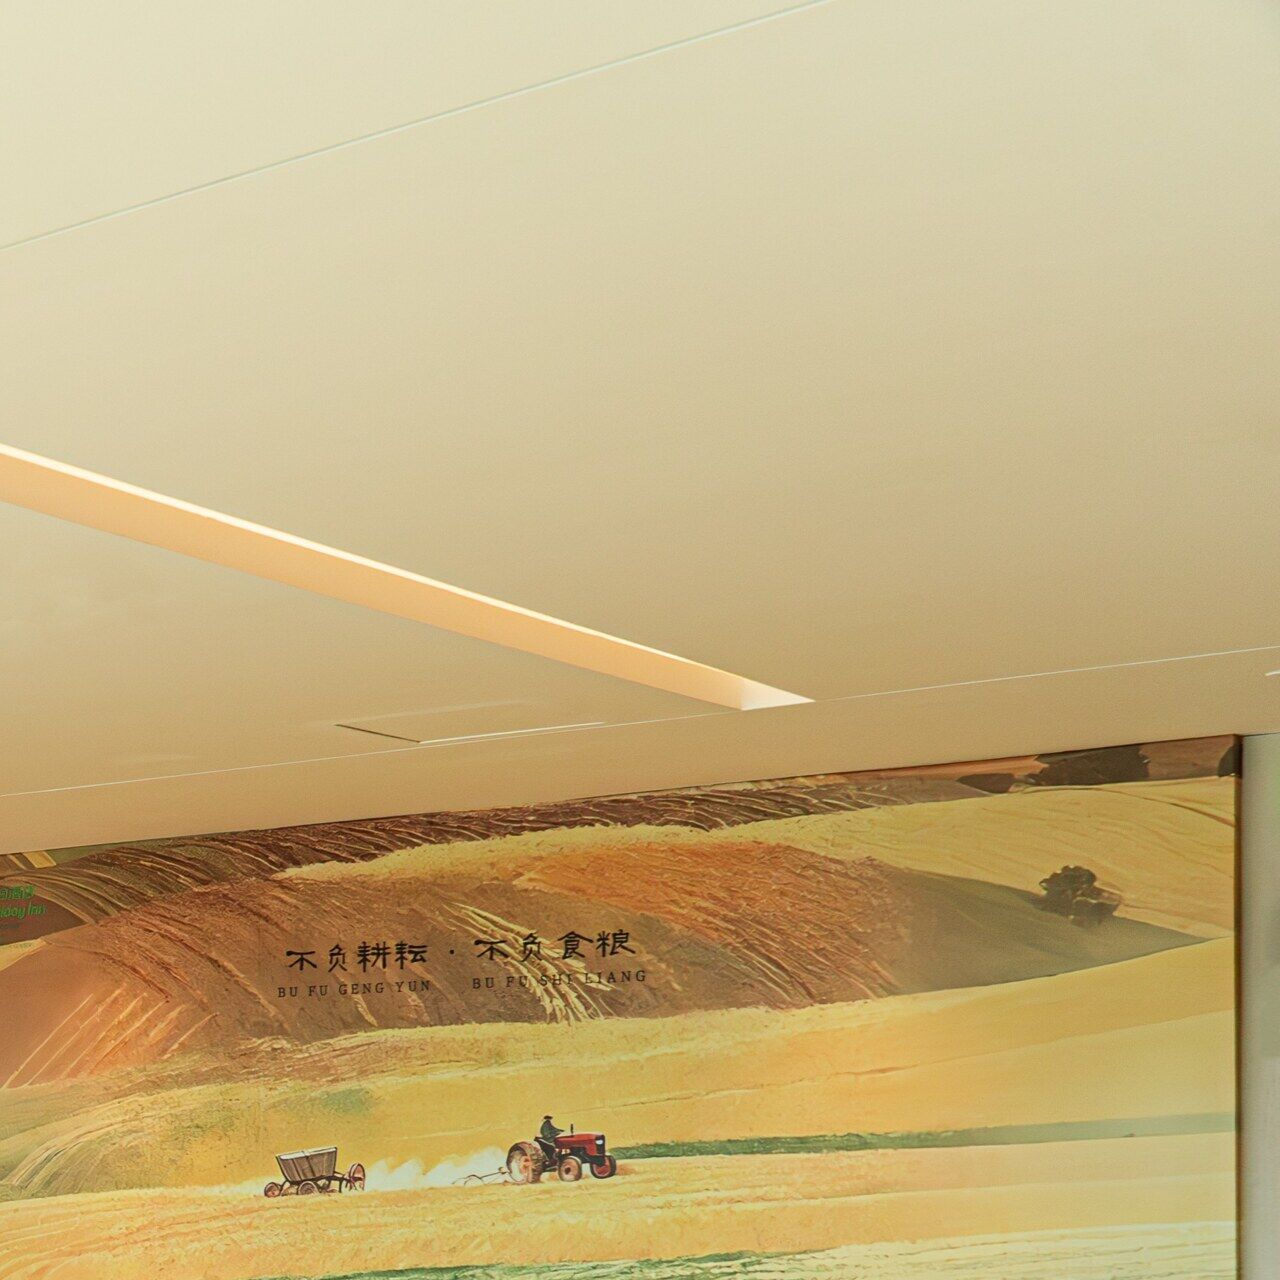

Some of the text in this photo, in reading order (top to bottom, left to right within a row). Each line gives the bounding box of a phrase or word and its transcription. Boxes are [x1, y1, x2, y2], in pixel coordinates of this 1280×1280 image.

[278, 987, 298, 998] BU
[309, 985, 328, 996] FU
[338, 983, 384, 995] GENG
[395, 980, 431, 993] YUN
[472, 977, 495, 989] BU
[585, 970, 646, 984] LIANG
